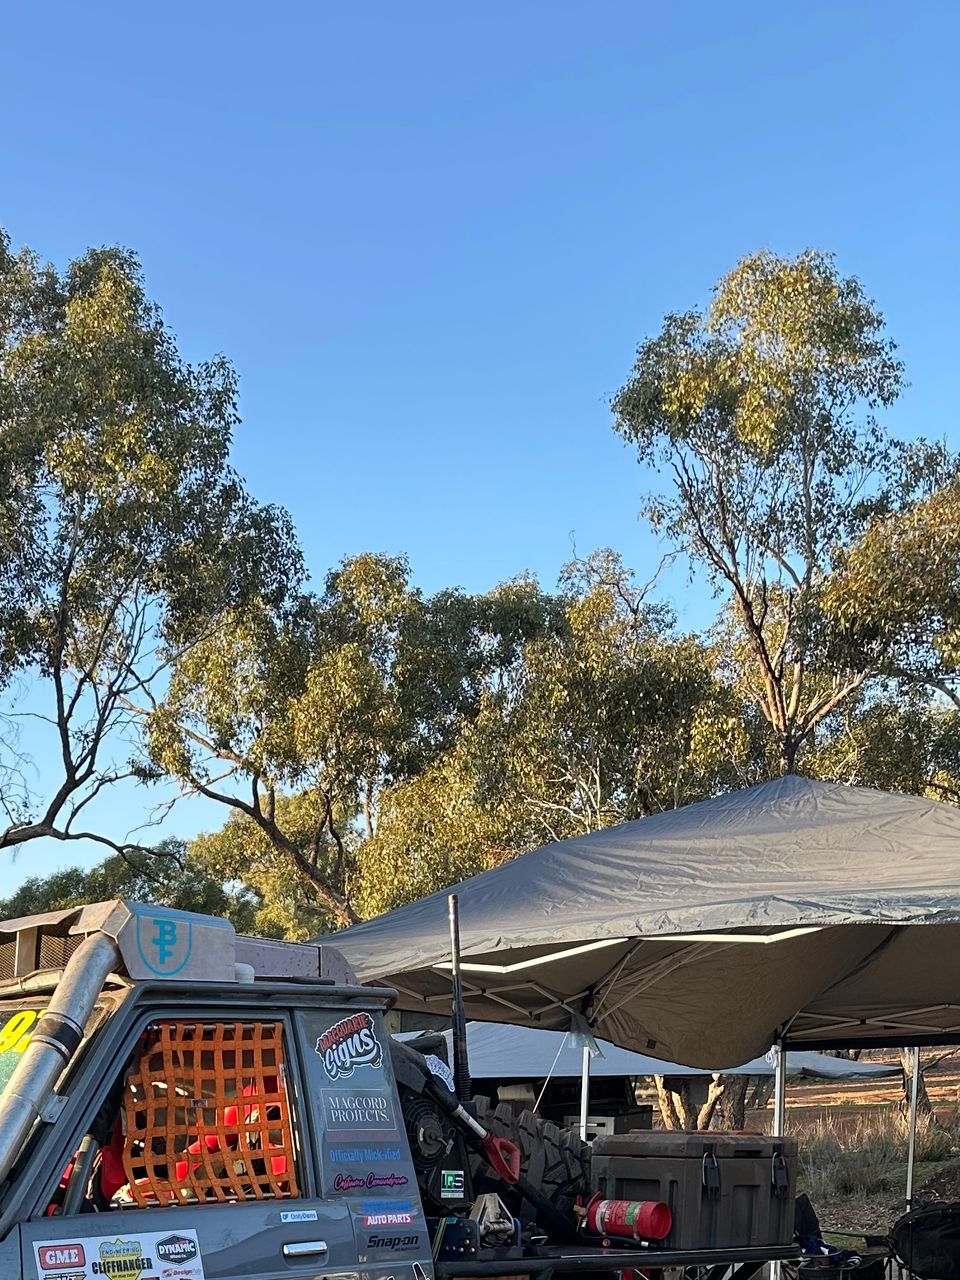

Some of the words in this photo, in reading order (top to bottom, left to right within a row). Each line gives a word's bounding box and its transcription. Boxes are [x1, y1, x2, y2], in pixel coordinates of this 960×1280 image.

[325, 1028, 375, 1075] Signs
[329, 1096, 387, 1109] MAGCORD
[367, 1214, 387, 1225] AUTO
[387, 1213, 411, 1223] PARTS
[158, 1242, 196, 1255] DYNAMIC
[367, 1235, 419, 1249] Snap-on
[44, 1248, 80, 1265] GME
[91, 1256, 153, 1275] CLIFFHANGER
